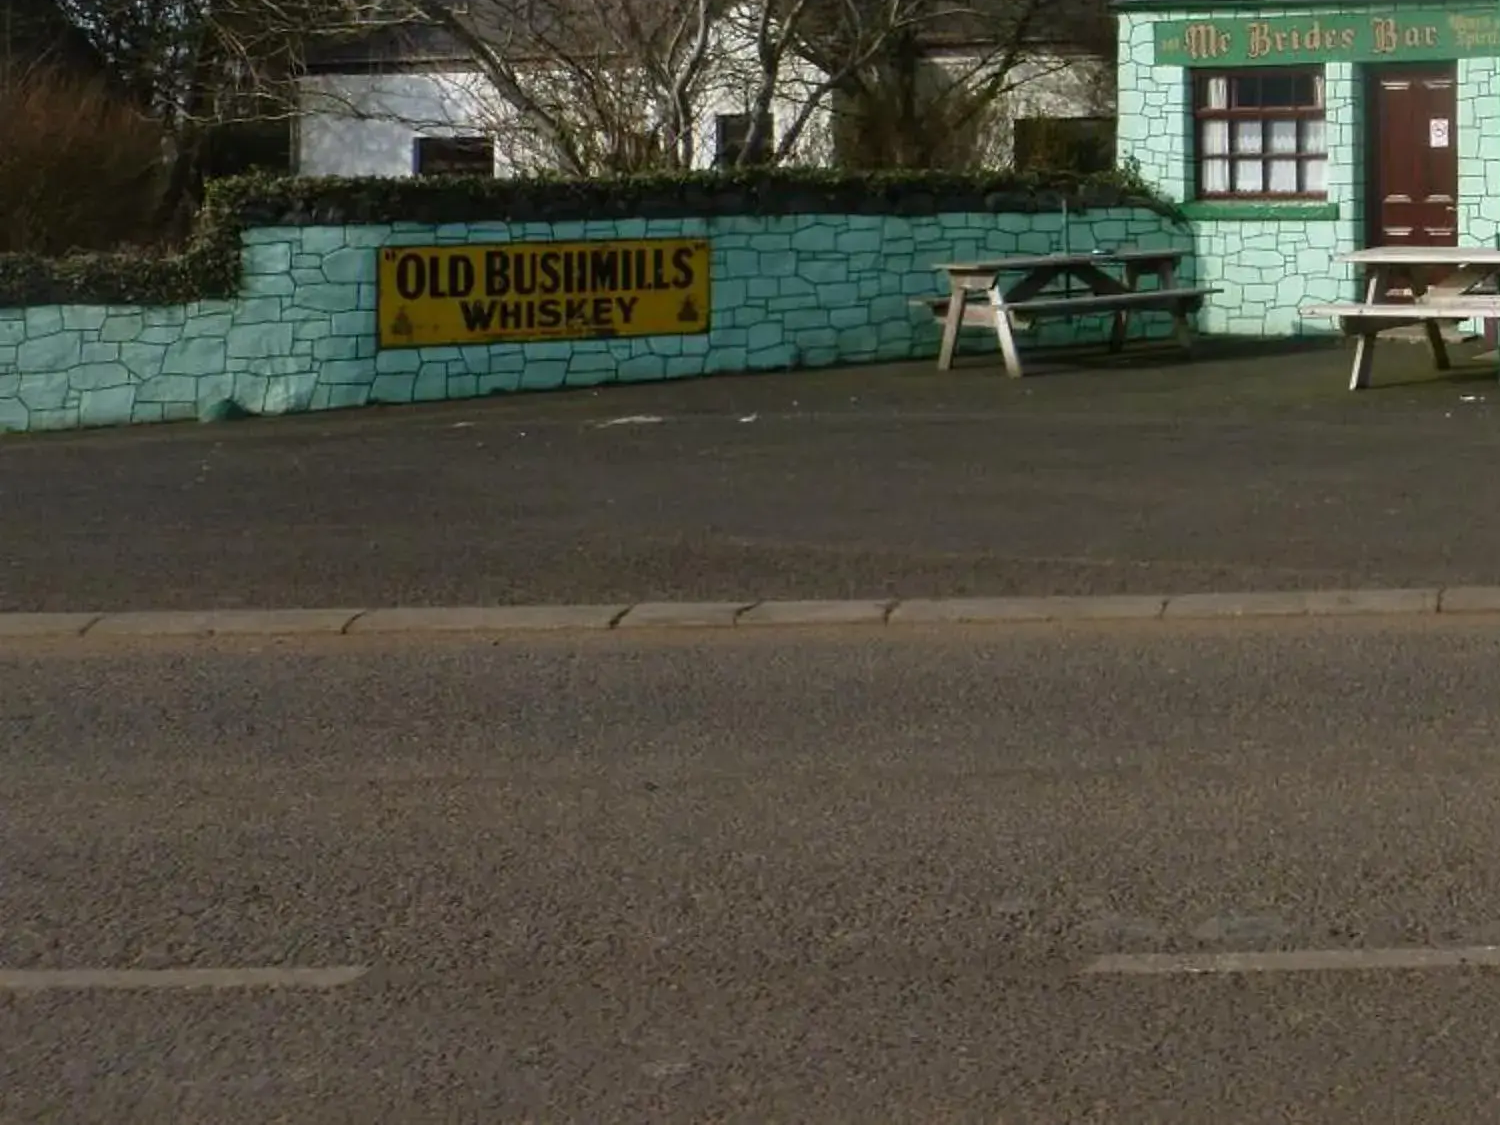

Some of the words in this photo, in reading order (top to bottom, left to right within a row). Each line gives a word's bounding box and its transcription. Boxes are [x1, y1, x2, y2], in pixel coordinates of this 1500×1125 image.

[1248, 21, 1355, 59] Brides
[1373, 16, 1437, 54] Bar
[459, 297, 640, 332] WHISKEY
